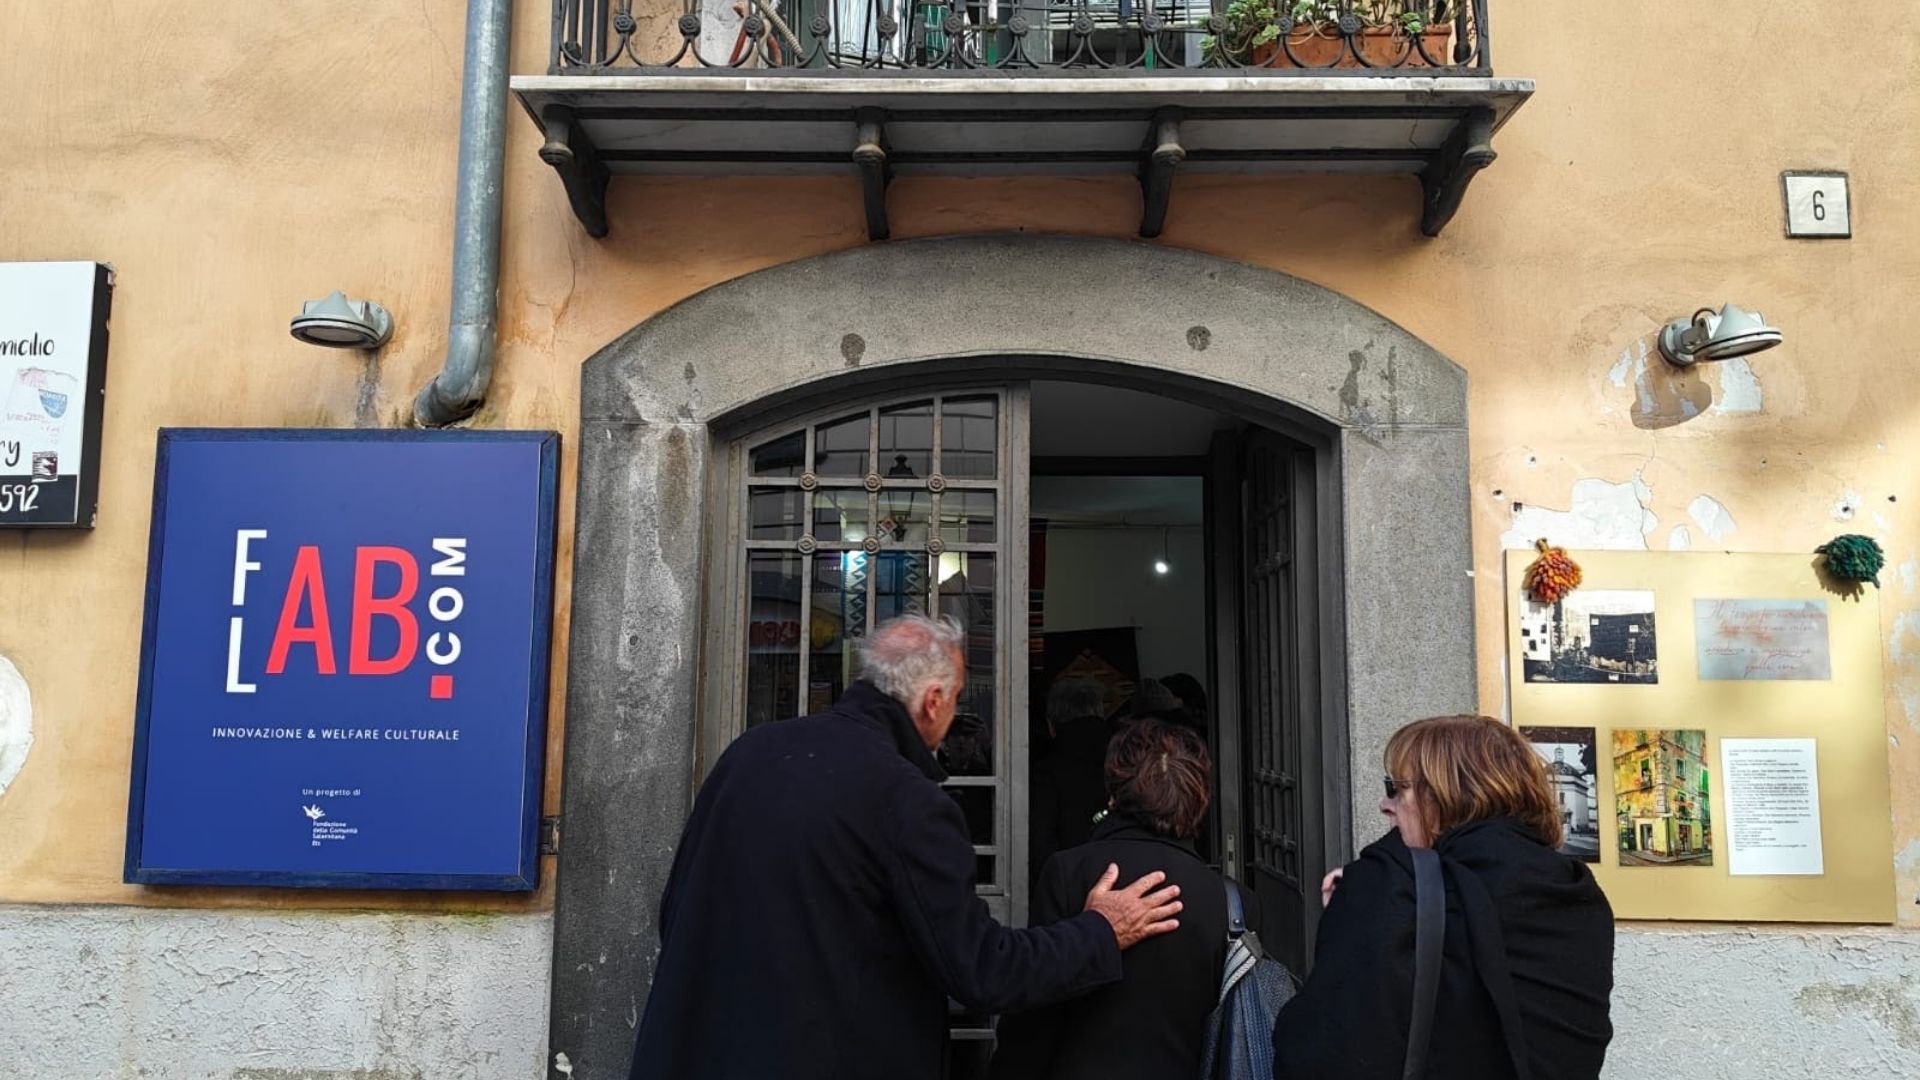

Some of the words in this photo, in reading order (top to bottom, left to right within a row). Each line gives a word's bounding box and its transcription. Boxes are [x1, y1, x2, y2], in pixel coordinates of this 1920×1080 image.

[1812, 189, 1825, 221] 6
[0, 484, 39, 512] 592
[212, 727, 303, 739] INNOVAZIONE
[306, 728, 317, 740] &
[321, 728, 379, 740] WELFARE
[384, 729, 460, 741] CULTURALE
[302, 788, 314, 796] Un
[316, 788, 351, 797] progetto
[353, 788, 361, 796] di
